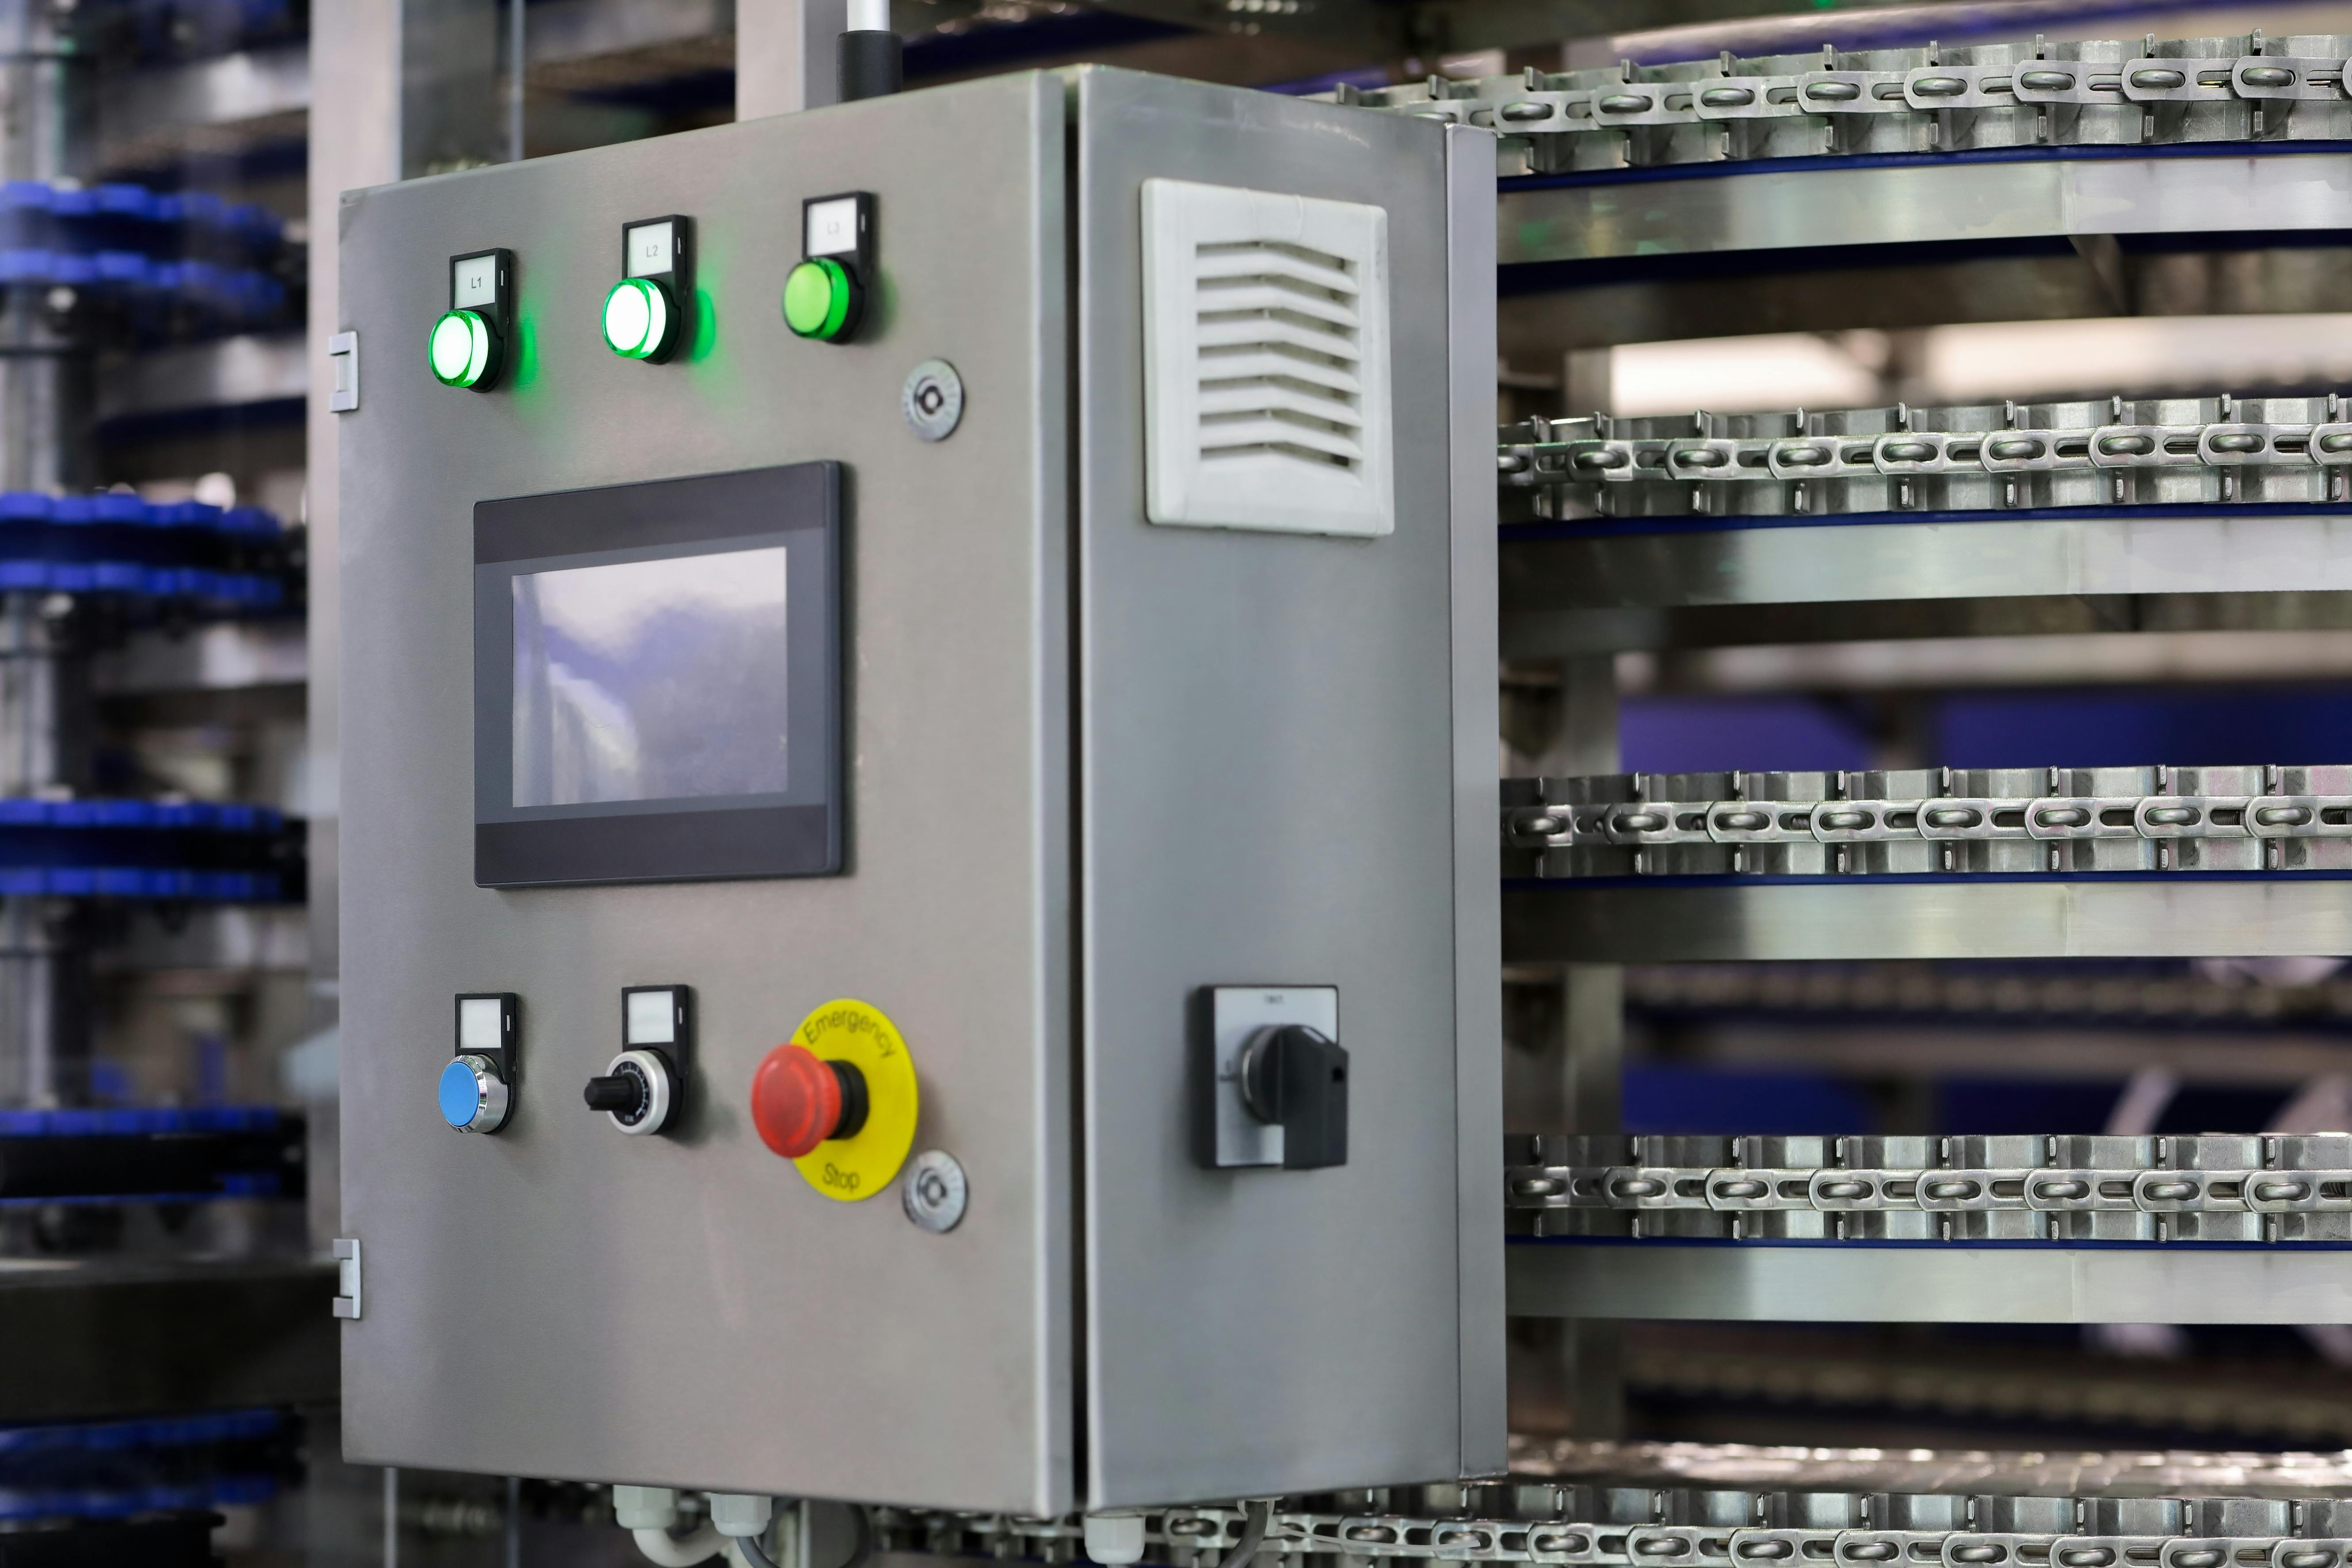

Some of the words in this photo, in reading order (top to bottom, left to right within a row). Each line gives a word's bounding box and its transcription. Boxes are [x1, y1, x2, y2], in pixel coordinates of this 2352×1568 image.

[646, 245, 658, 257] L2
[471, 276, 481, 289] L1
[804, 1011, 896, 1058] Emergency
[822, 1162, 860, 1194] Stop
